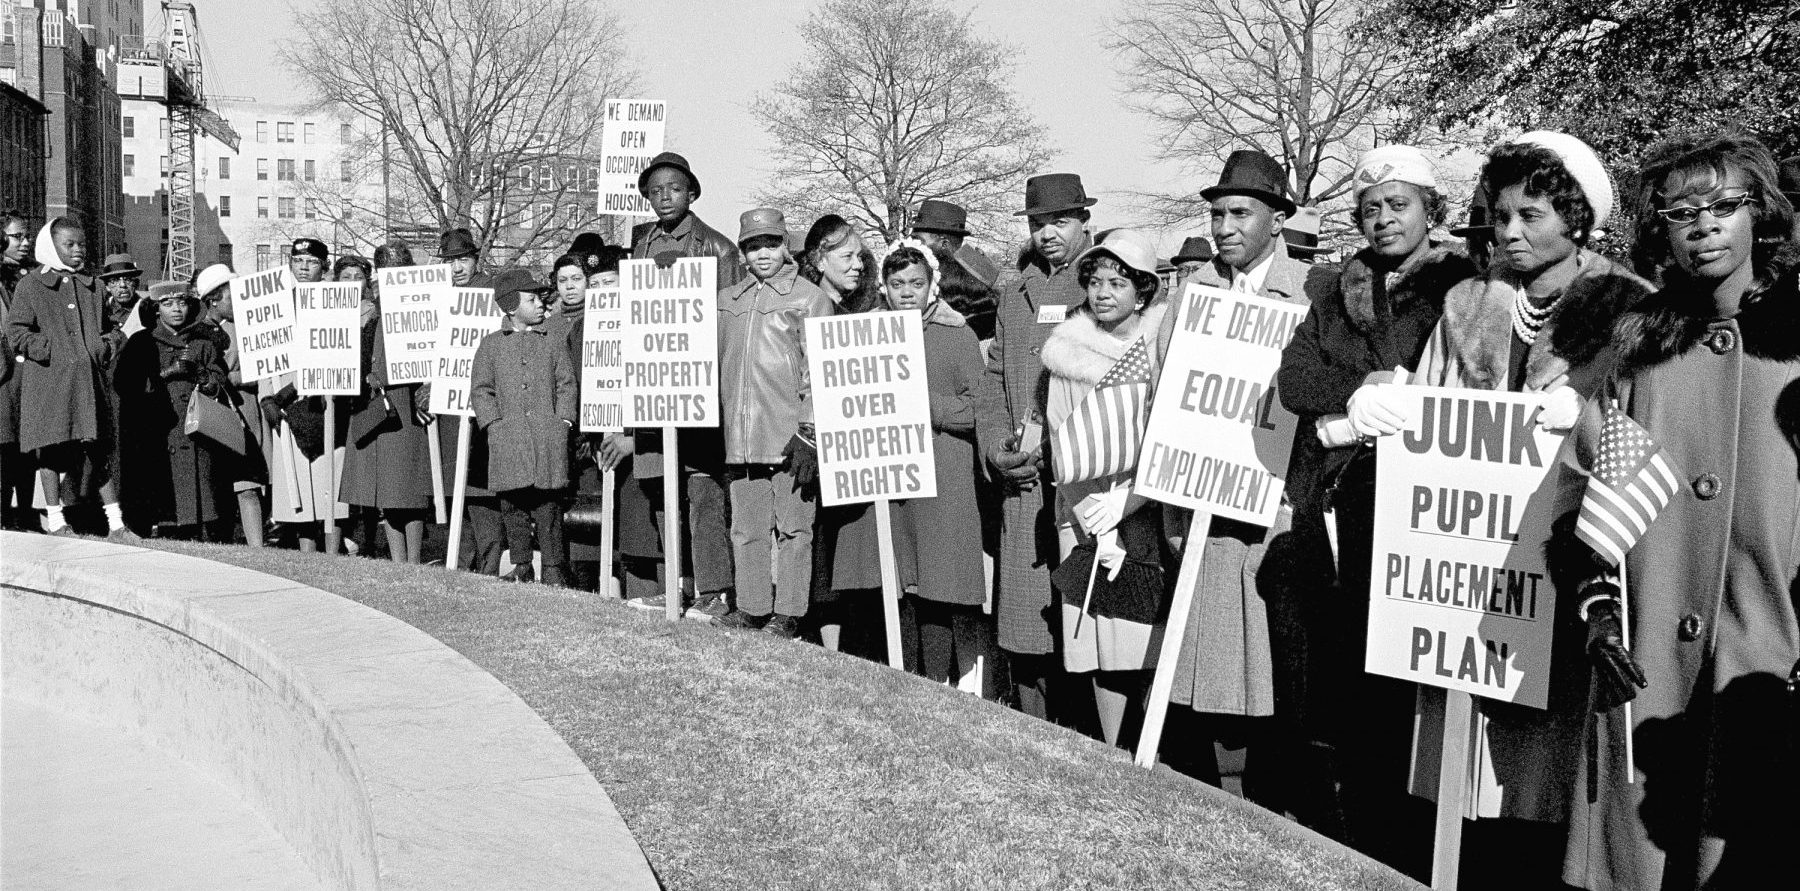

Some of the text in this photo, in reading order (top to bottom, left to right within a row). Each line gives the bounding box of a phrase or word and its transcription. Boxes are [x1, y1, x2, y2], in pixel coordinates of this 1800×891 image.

[609, 103, 664, 121] WE DEMAND
[621, 131, 646, 148] OPEN
[606, 155, 654, 174] OCCUPANC
[605, 193, 650, 213] HOUSING
[240, 270, 285, 301] JUNK
[385, 268, 446, 286] ACTION
[631, 262, 703, 291] HUMAN
[300, 287, 358, 309] WE DEMAND
[400, 294, 430, 302] FOR
[450, 291, 501, 318] JUNK
[246, 303, 283, 325] PUPIL
[631, 299, 703, 324] RIGHTS
[1184, 293, 1221, 335] WE
[243, 325, 293, 353] PLACEMENT
[310, 328, 352, 349] EQUAL
[644, 333, 688, 352] OVER
[820, 315, 906, 350] HUMAN
[407, 341, 436, 350] NOT
[256, 353, 290, 376] PLAN
[438, 357, 471, 378] PLACE
[625, 361, 712, 387] PROPERTY
[823, 354, 910, 387] RIGHTS
[303, 368, 356, 390] EMPLOYMENT
[597, 379, 622, 388] NOT
[634, 394, 705, 421] RIGHTS
[842, 393, 896, 418] OVER
[1178, 369, 1276, 431] EQUAL
[820, 423, 926, 464] PROPERTY
[1403, 396, 1543, 468] JUNK
[835, 463, 921, 499] RIGHTS
[1144, 441, 1273, 515] EMPLOYMENT
[1410, 485, 1519, 541] PUPIL
[1386, 552, 1543, 619] PLACEMENT
[1410, 626, 1508, 689] PLAN
